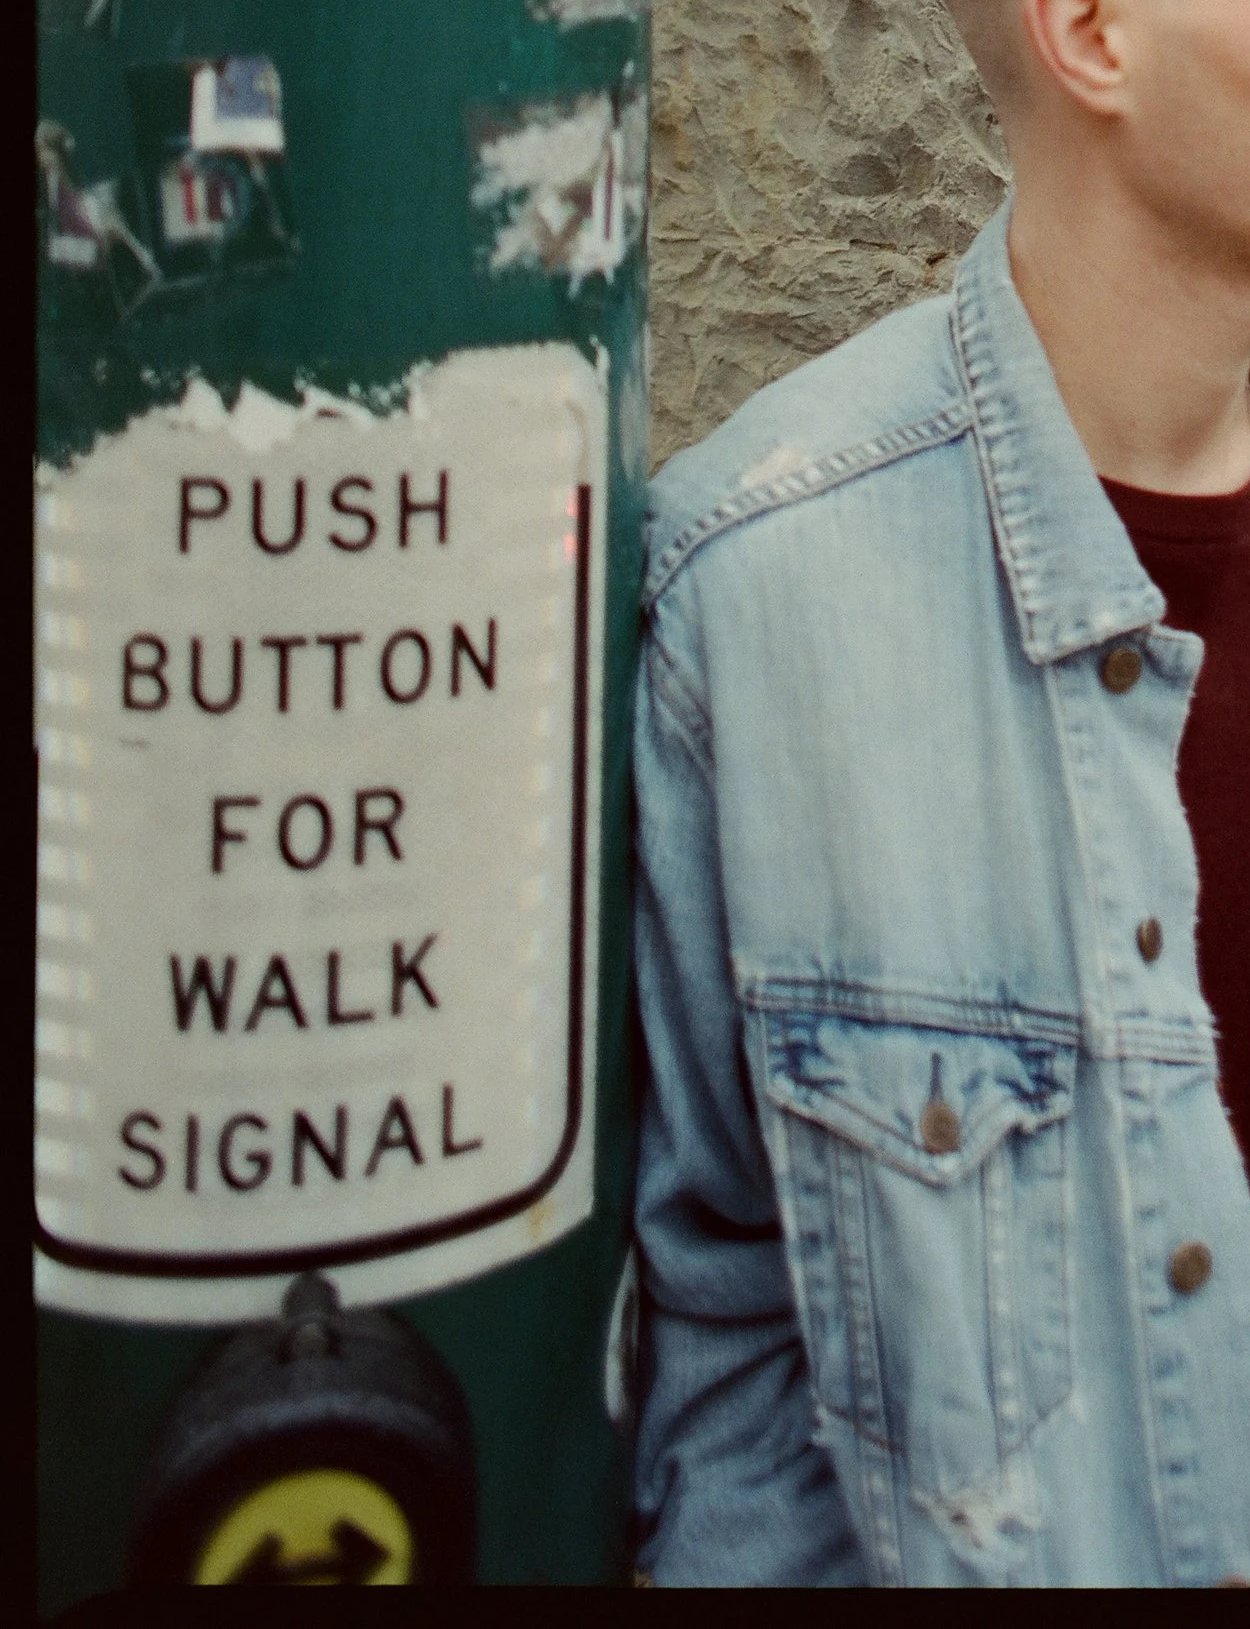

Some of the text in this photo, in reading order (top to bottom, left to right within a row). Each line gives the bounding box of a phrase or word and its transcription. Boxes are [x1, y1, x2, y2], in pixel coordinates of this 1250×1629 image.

[178, 469, 452, 557] PUSH
[121, 617, 499, 715] BUTTON
[211, 786, 407, 875] FOR
[169, 933, 442, 1034] WALK
[118, 1082, 484, 1192] SIGNAL
